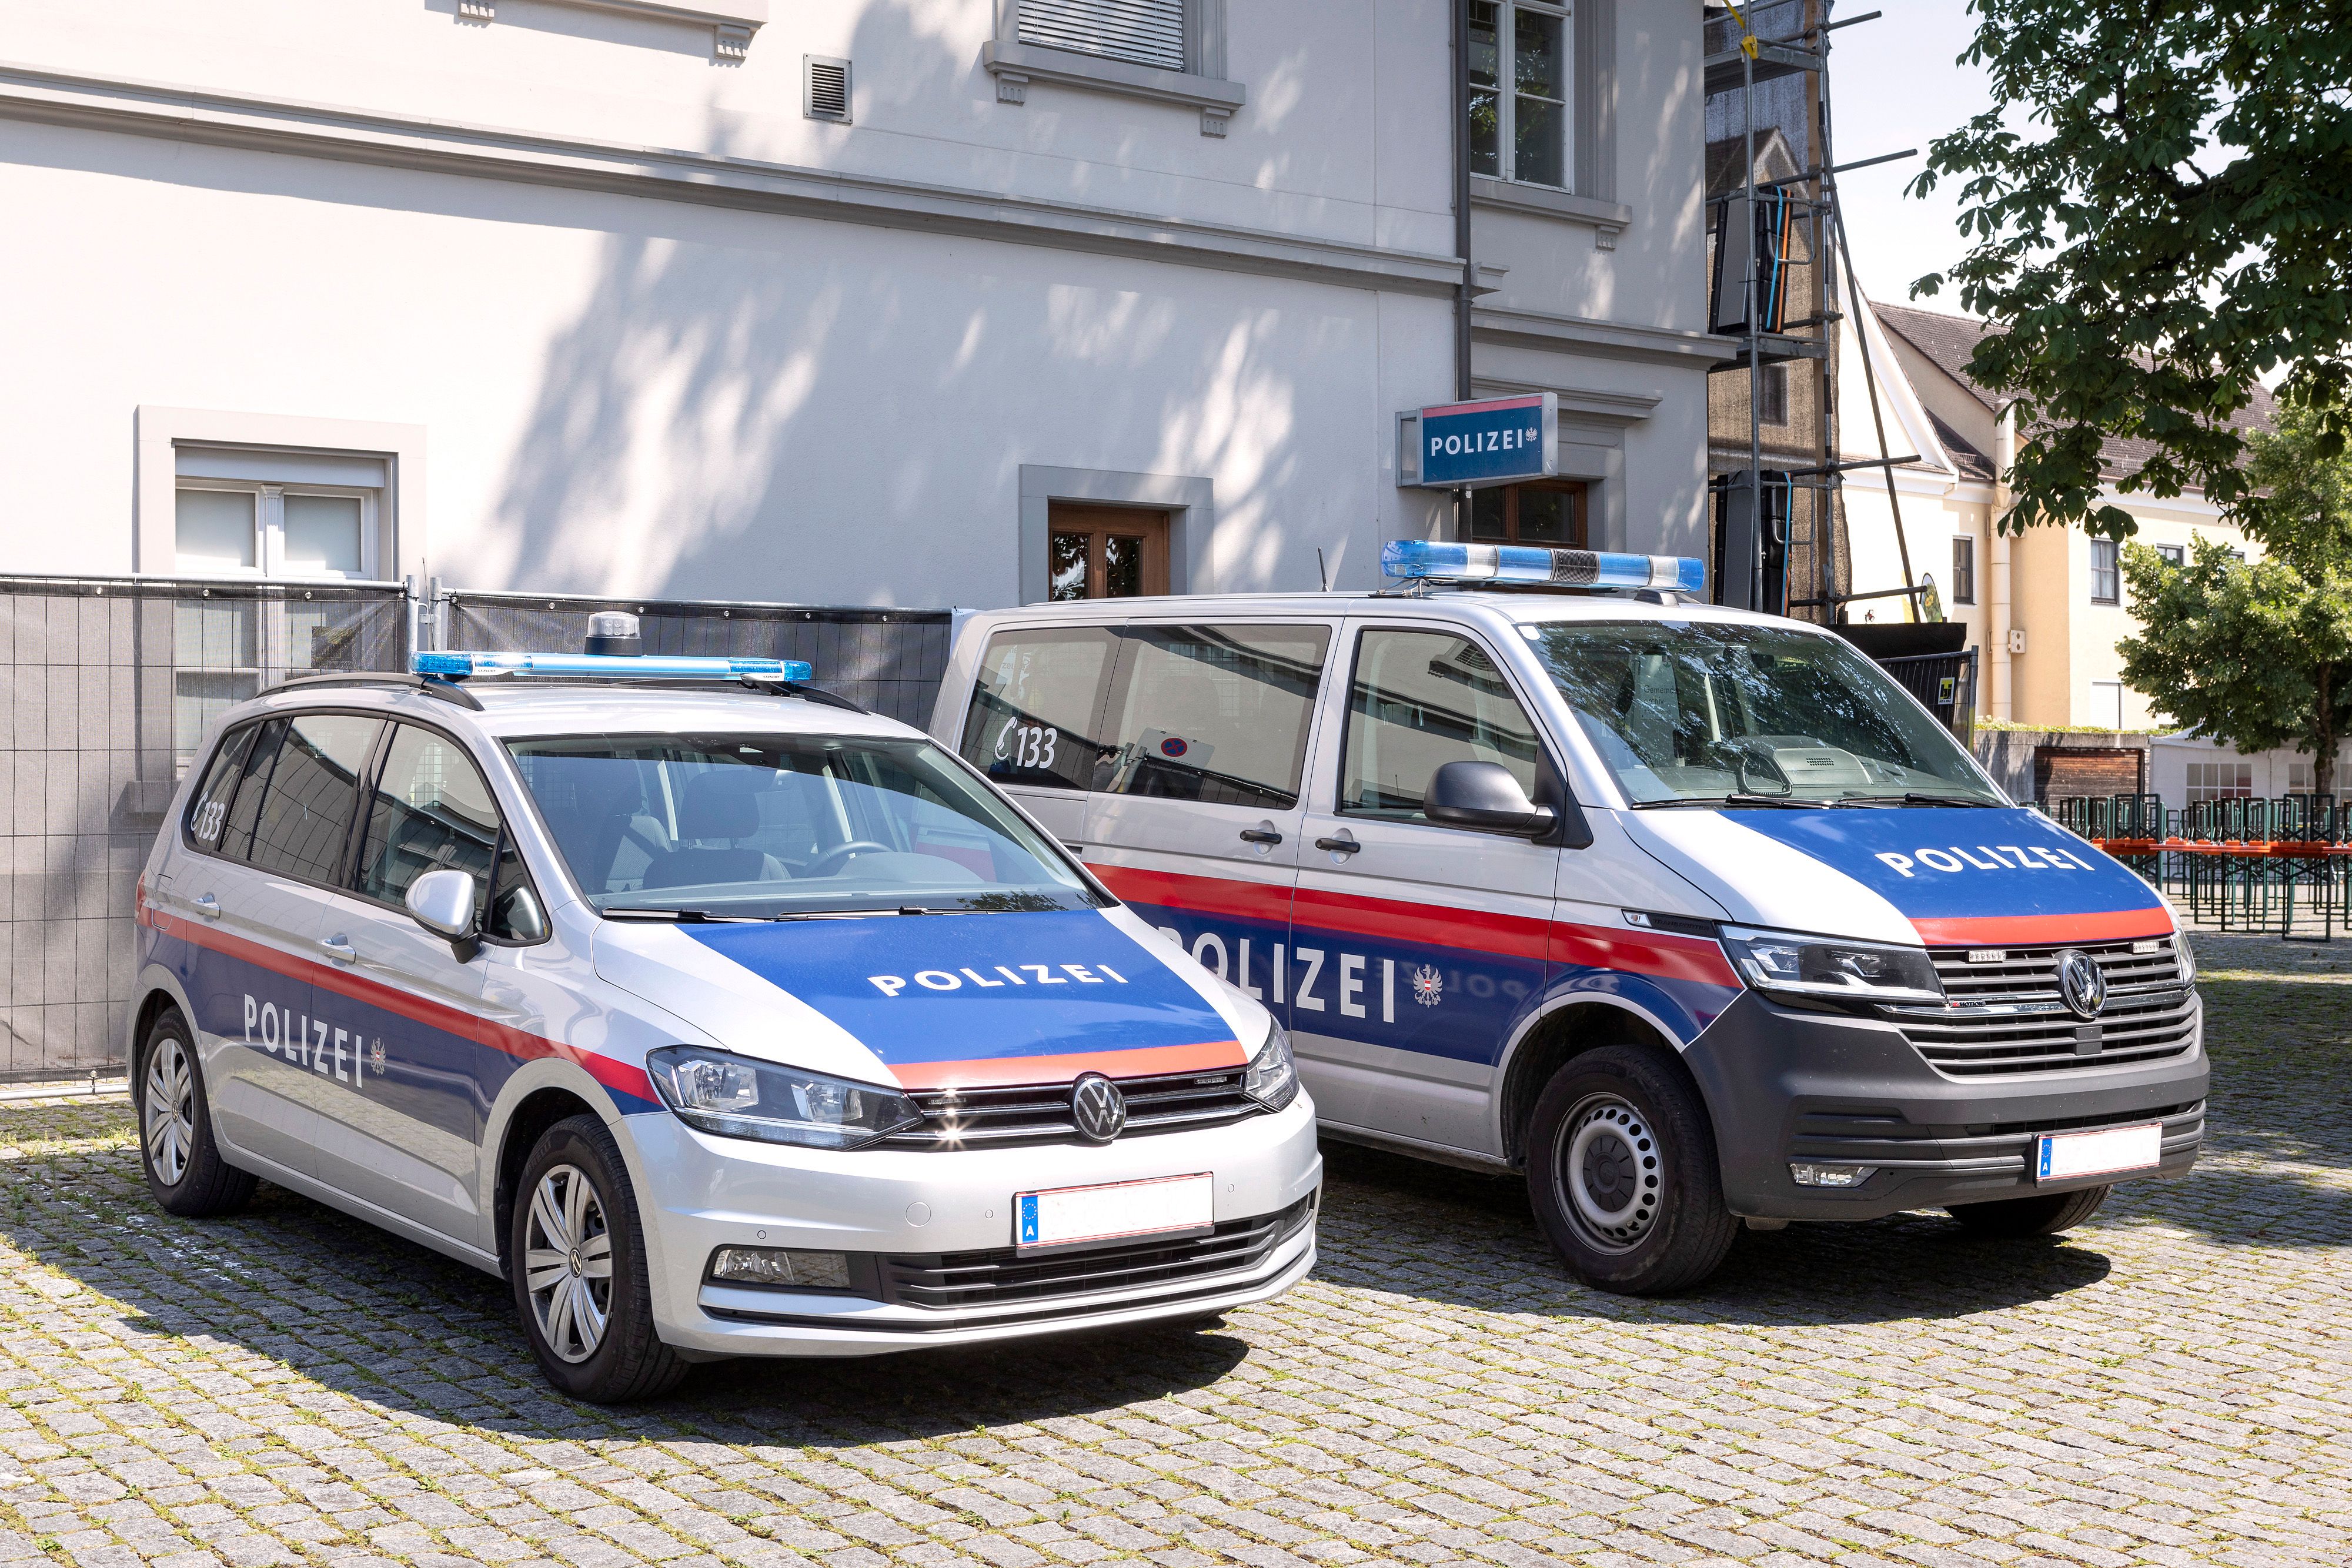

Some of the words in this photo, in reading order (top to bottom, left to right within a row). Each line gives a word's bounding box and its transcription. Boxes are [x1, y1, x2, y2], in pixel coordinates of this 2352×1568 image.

[1431, 429, 1522, 456] POLIZEI
[1017, 727, 1057, 768] 133
[199, 801, 225, 841] 133
[1874, 846, 2095, 878] POLIZEI
[1653, 918, 1709, 931] TRANSPORTER
[867, 964, 1129, 997] POLIZEI
[245, 994, 362, 1088] POLIZEI
[2042, 1162, 2048, 1171] A
[1025, 1225, 1035, 1237] A
